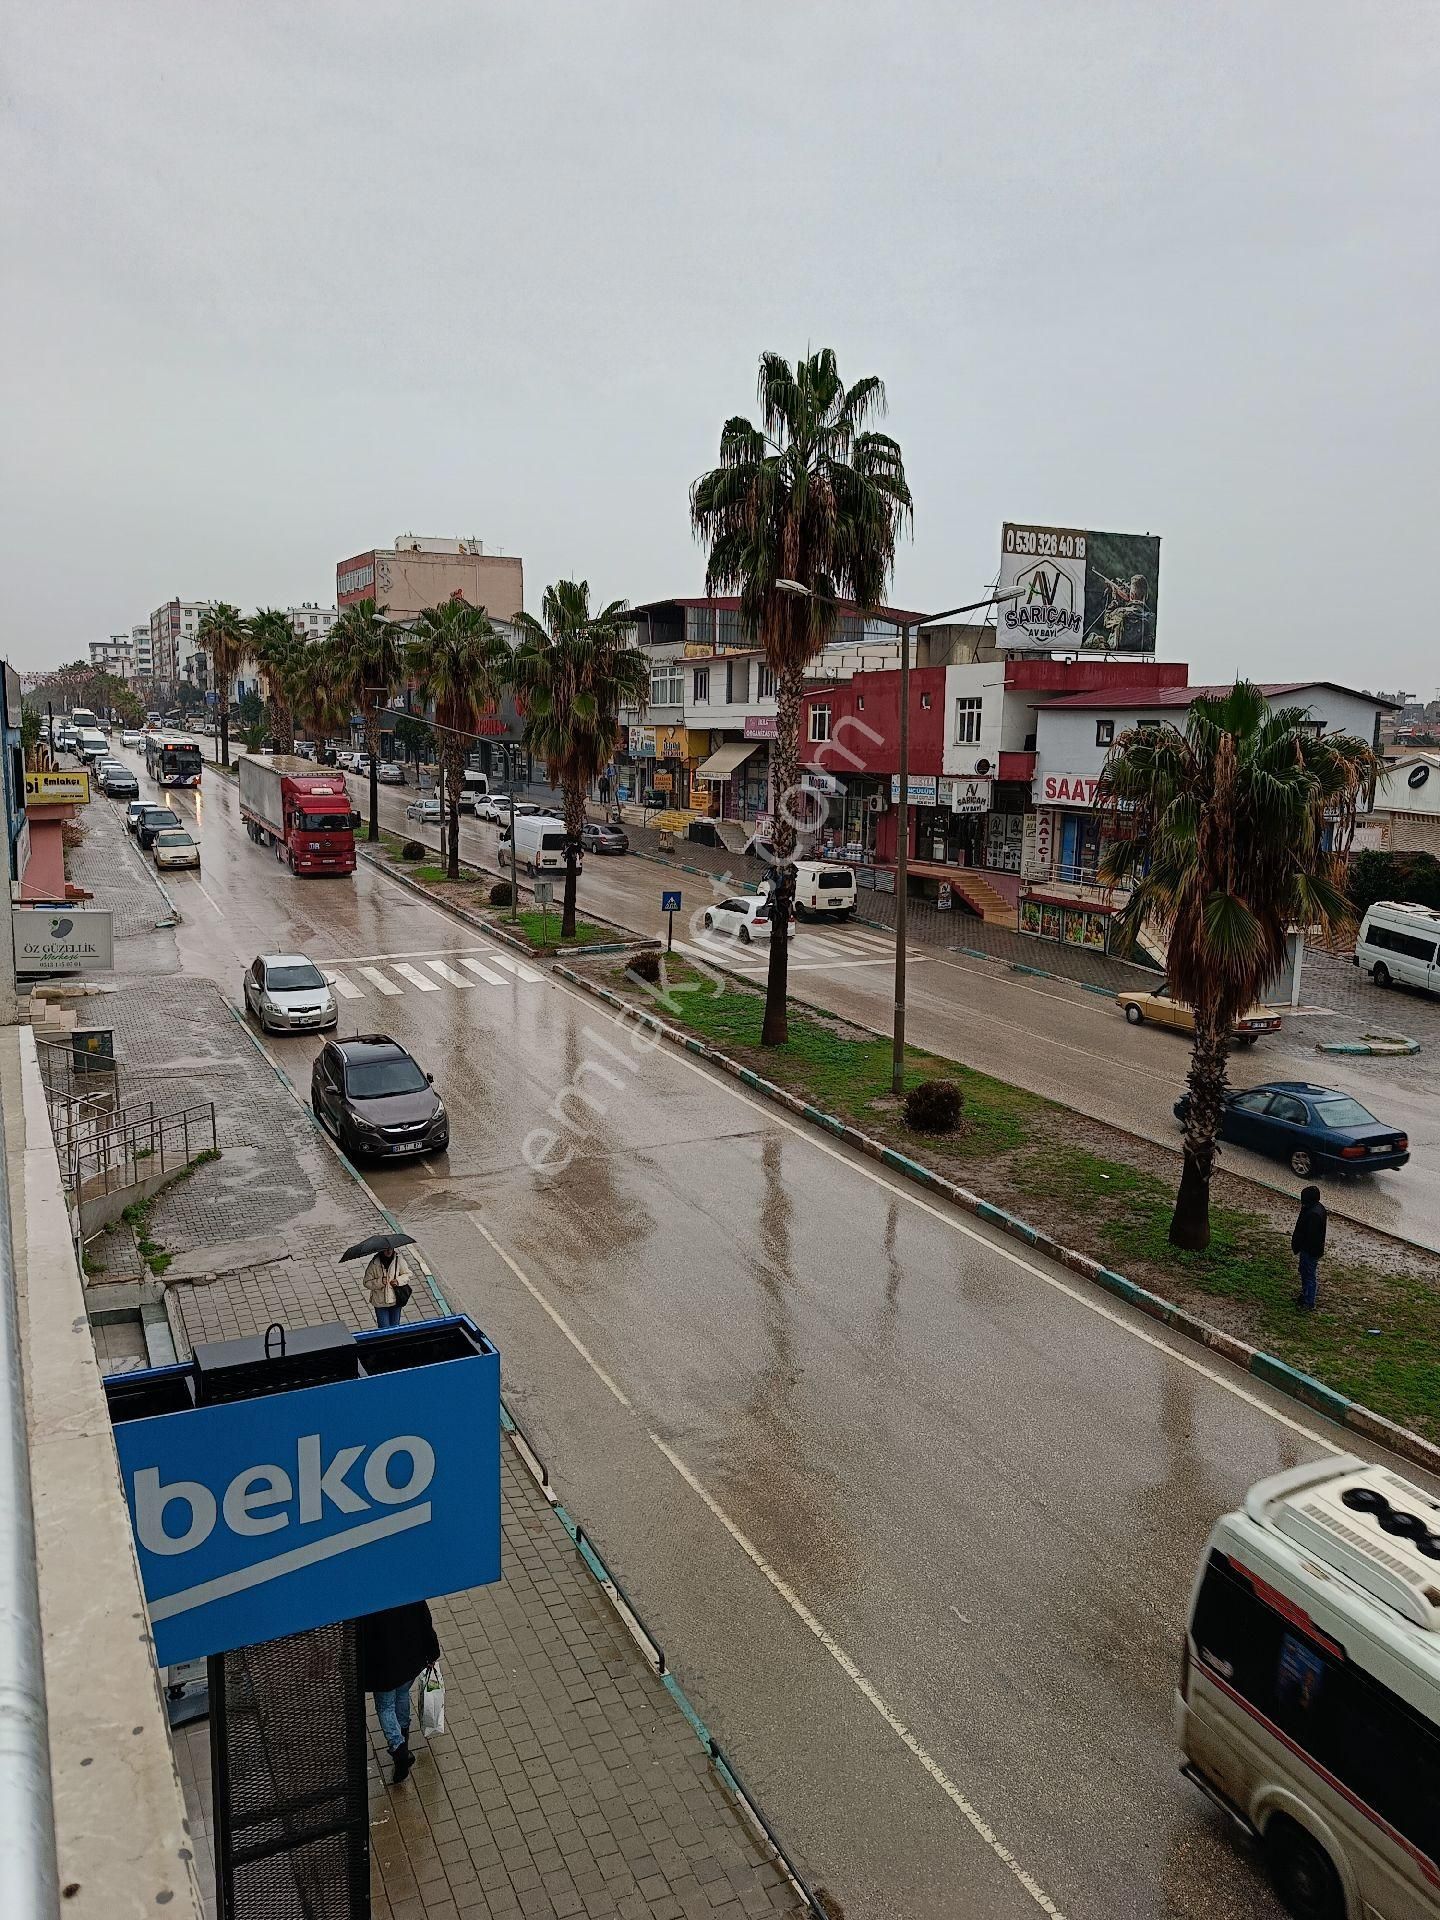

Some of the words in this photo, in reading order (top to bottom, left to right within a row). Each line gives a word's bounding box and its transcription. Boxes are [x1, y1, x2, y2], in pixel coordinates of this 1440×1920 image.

[1006, 529, 1014, 552] 0
[1015, 530, 1036, 554] 530
[1058, 535, 1074, 557] 40
[1026, 571, 1061, 605] AV
[1005, 606, 1082, 633] SARIÇAM
[1028, 629, 1040, 637] AV
[1040, 628, 1057, 638] BAYİ
[24, 943, 40, 954] ÖZ
[42, 942, 96, 954] GÜZELLİK
[134, 1433, 436, 1556] beko
